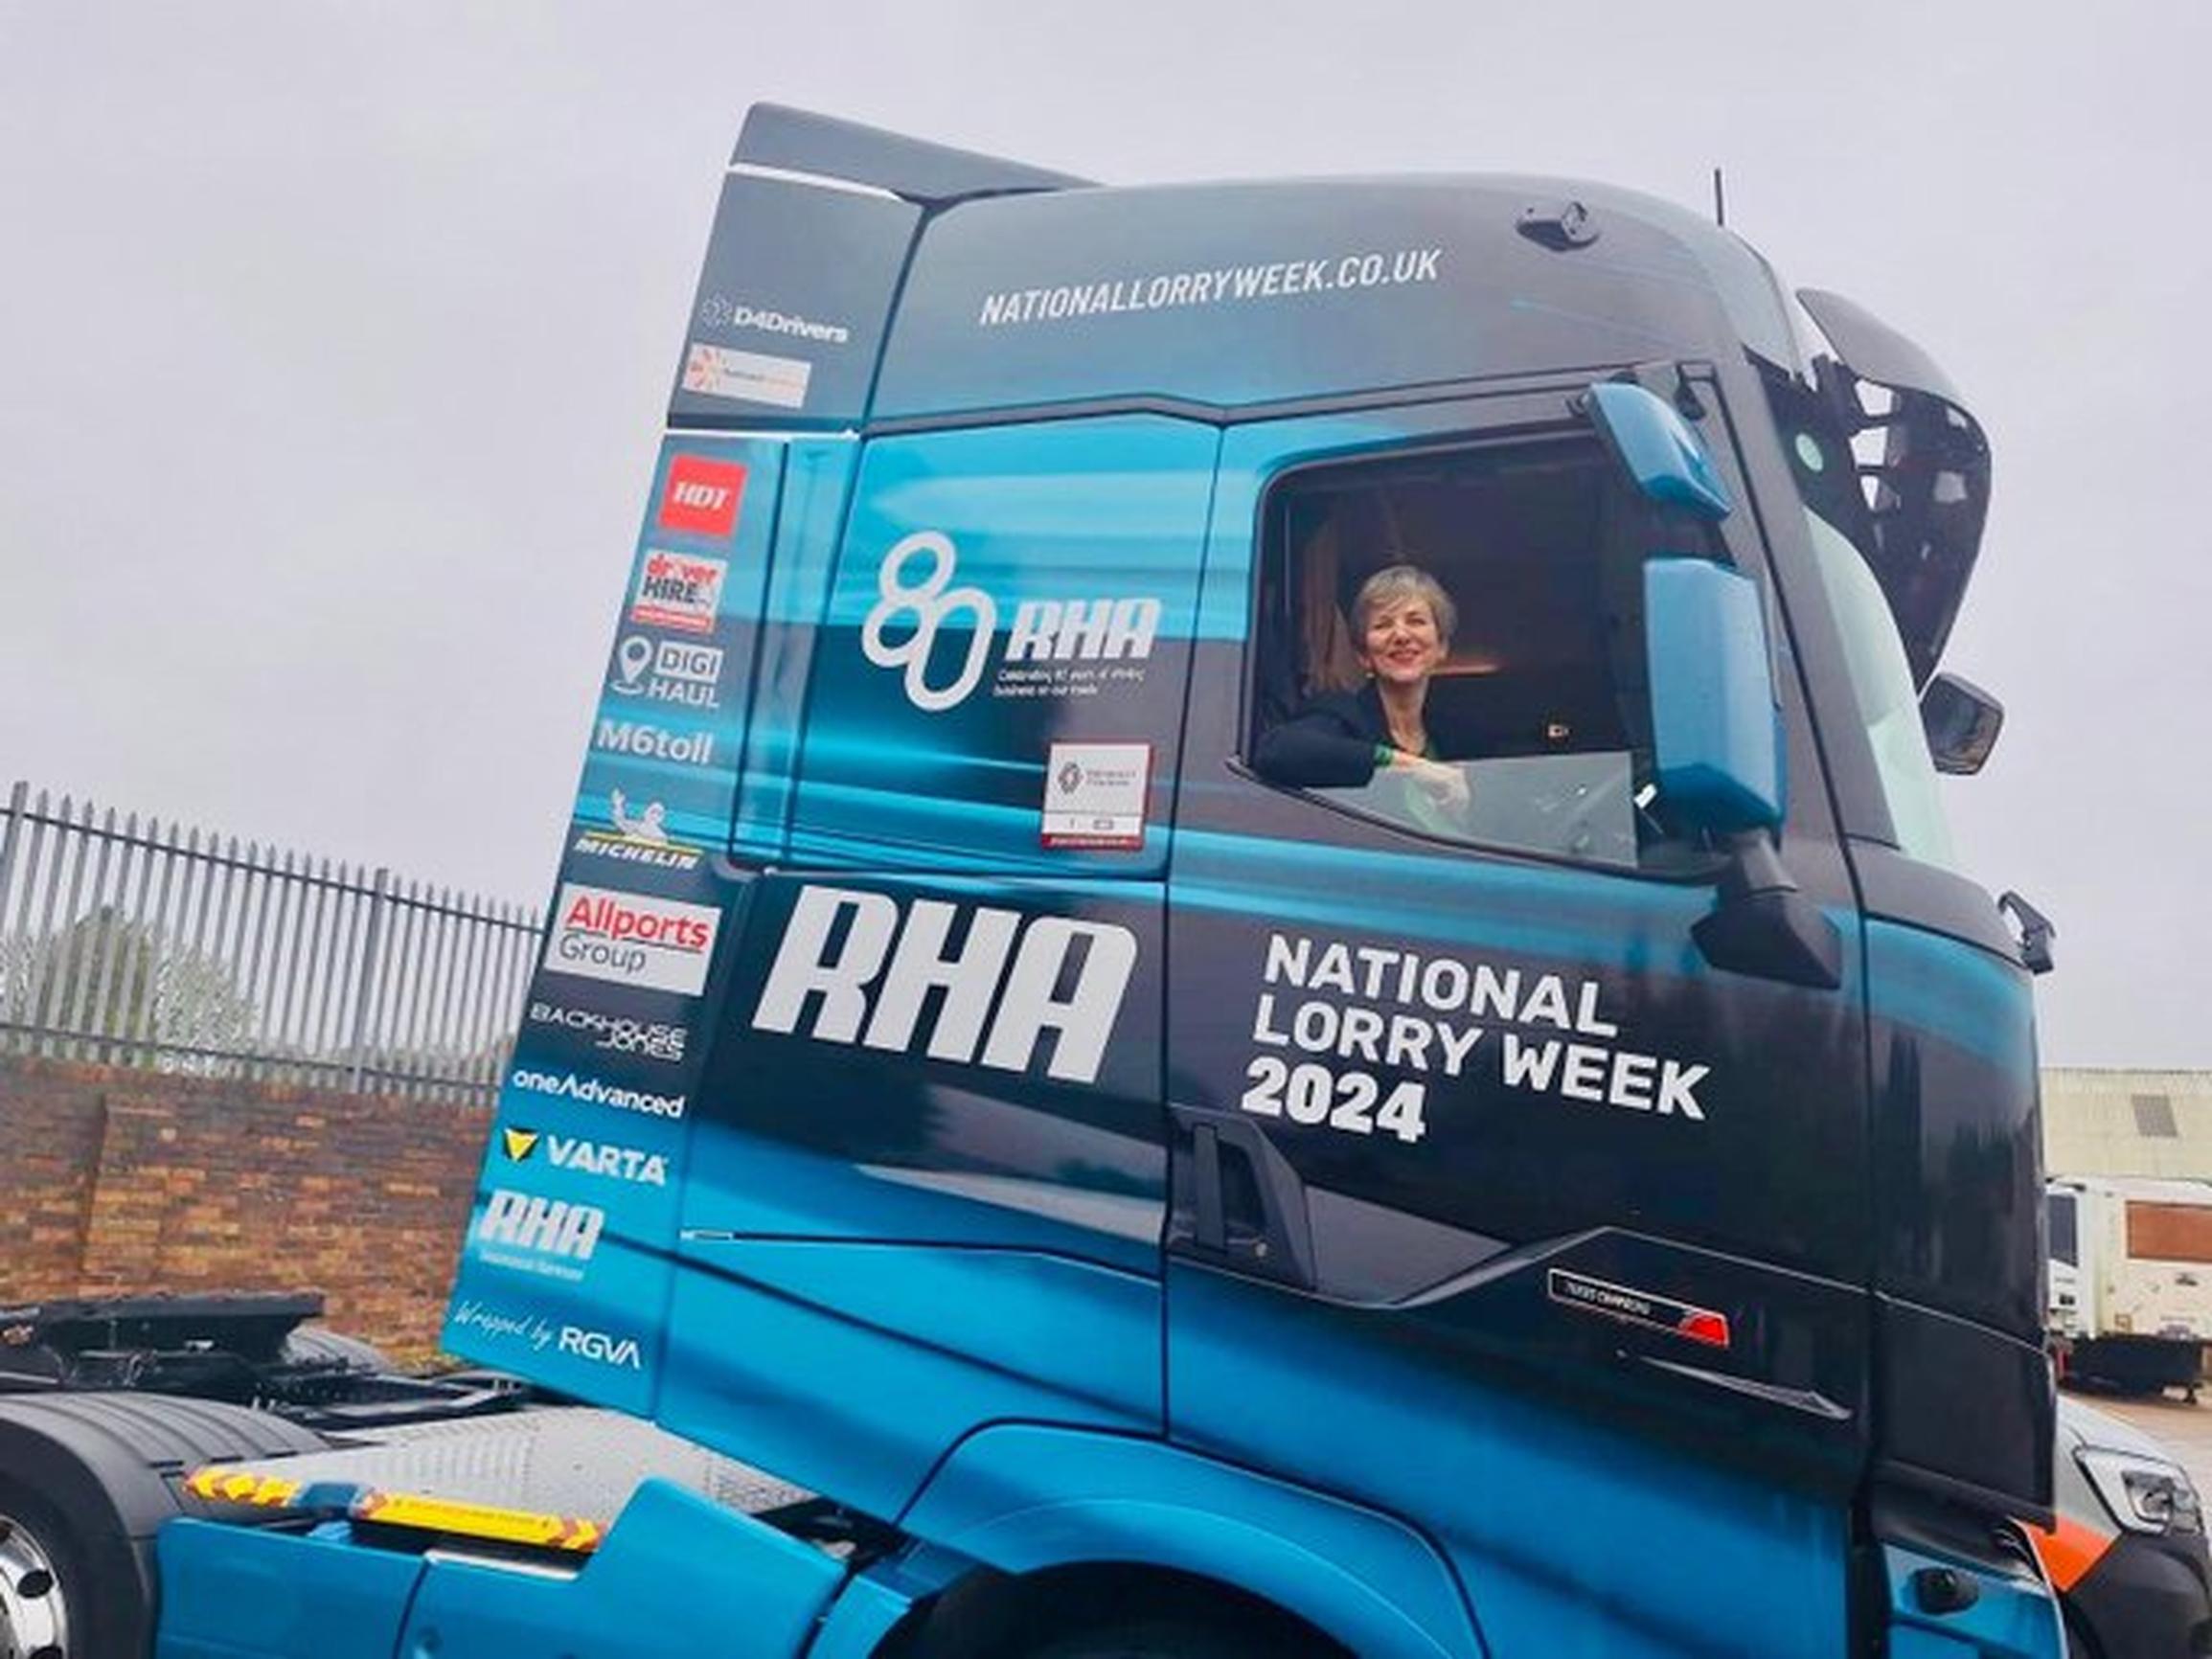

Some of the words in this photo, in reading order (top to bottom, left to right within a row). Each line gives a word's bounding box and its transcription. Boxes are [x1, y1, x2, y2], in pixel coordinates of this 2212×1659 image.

[979, 249, 1441, 326] NATIONALLORRYWEEK.CO.UK
[733, 305, 849, 343] D4Drivers
[642, 575, 701, 603] HIRE
[862, 530, 996, 711] 80
[1005, 598, 1161, 661] RHA
[661, 648, 718, 676] DIGI
[648, 678, 720, 709] HAUL
[597, 719, 714, 764] M6toll
[574, 838, 700, 871] MICHELIN
[567, 896, 710, 948] Allports
[559, 933, 647, 973] Group
[751, 884, 1138, 1083] RHA
[1265, 933, 1619, 1037] NATIONAL
[529, 1002, 689, 1044] BACKHOUSE
[1252, 993, 1483, 1077] LORRY
[1501, 1034, 1711, 1121] WEEK
[513, 1069, 686, 1119] oneAdvanced
[1241, 1056, 1428, 1144] 2024
[547, 1134, 668, 1187] VARTA
[479, 1189, 604, 1261] RHA
[453, 1300, 526, 1337] Wrapped
[530, 1317, 554, 1352] by
[558, 1326, 642, 1370] RGVA
